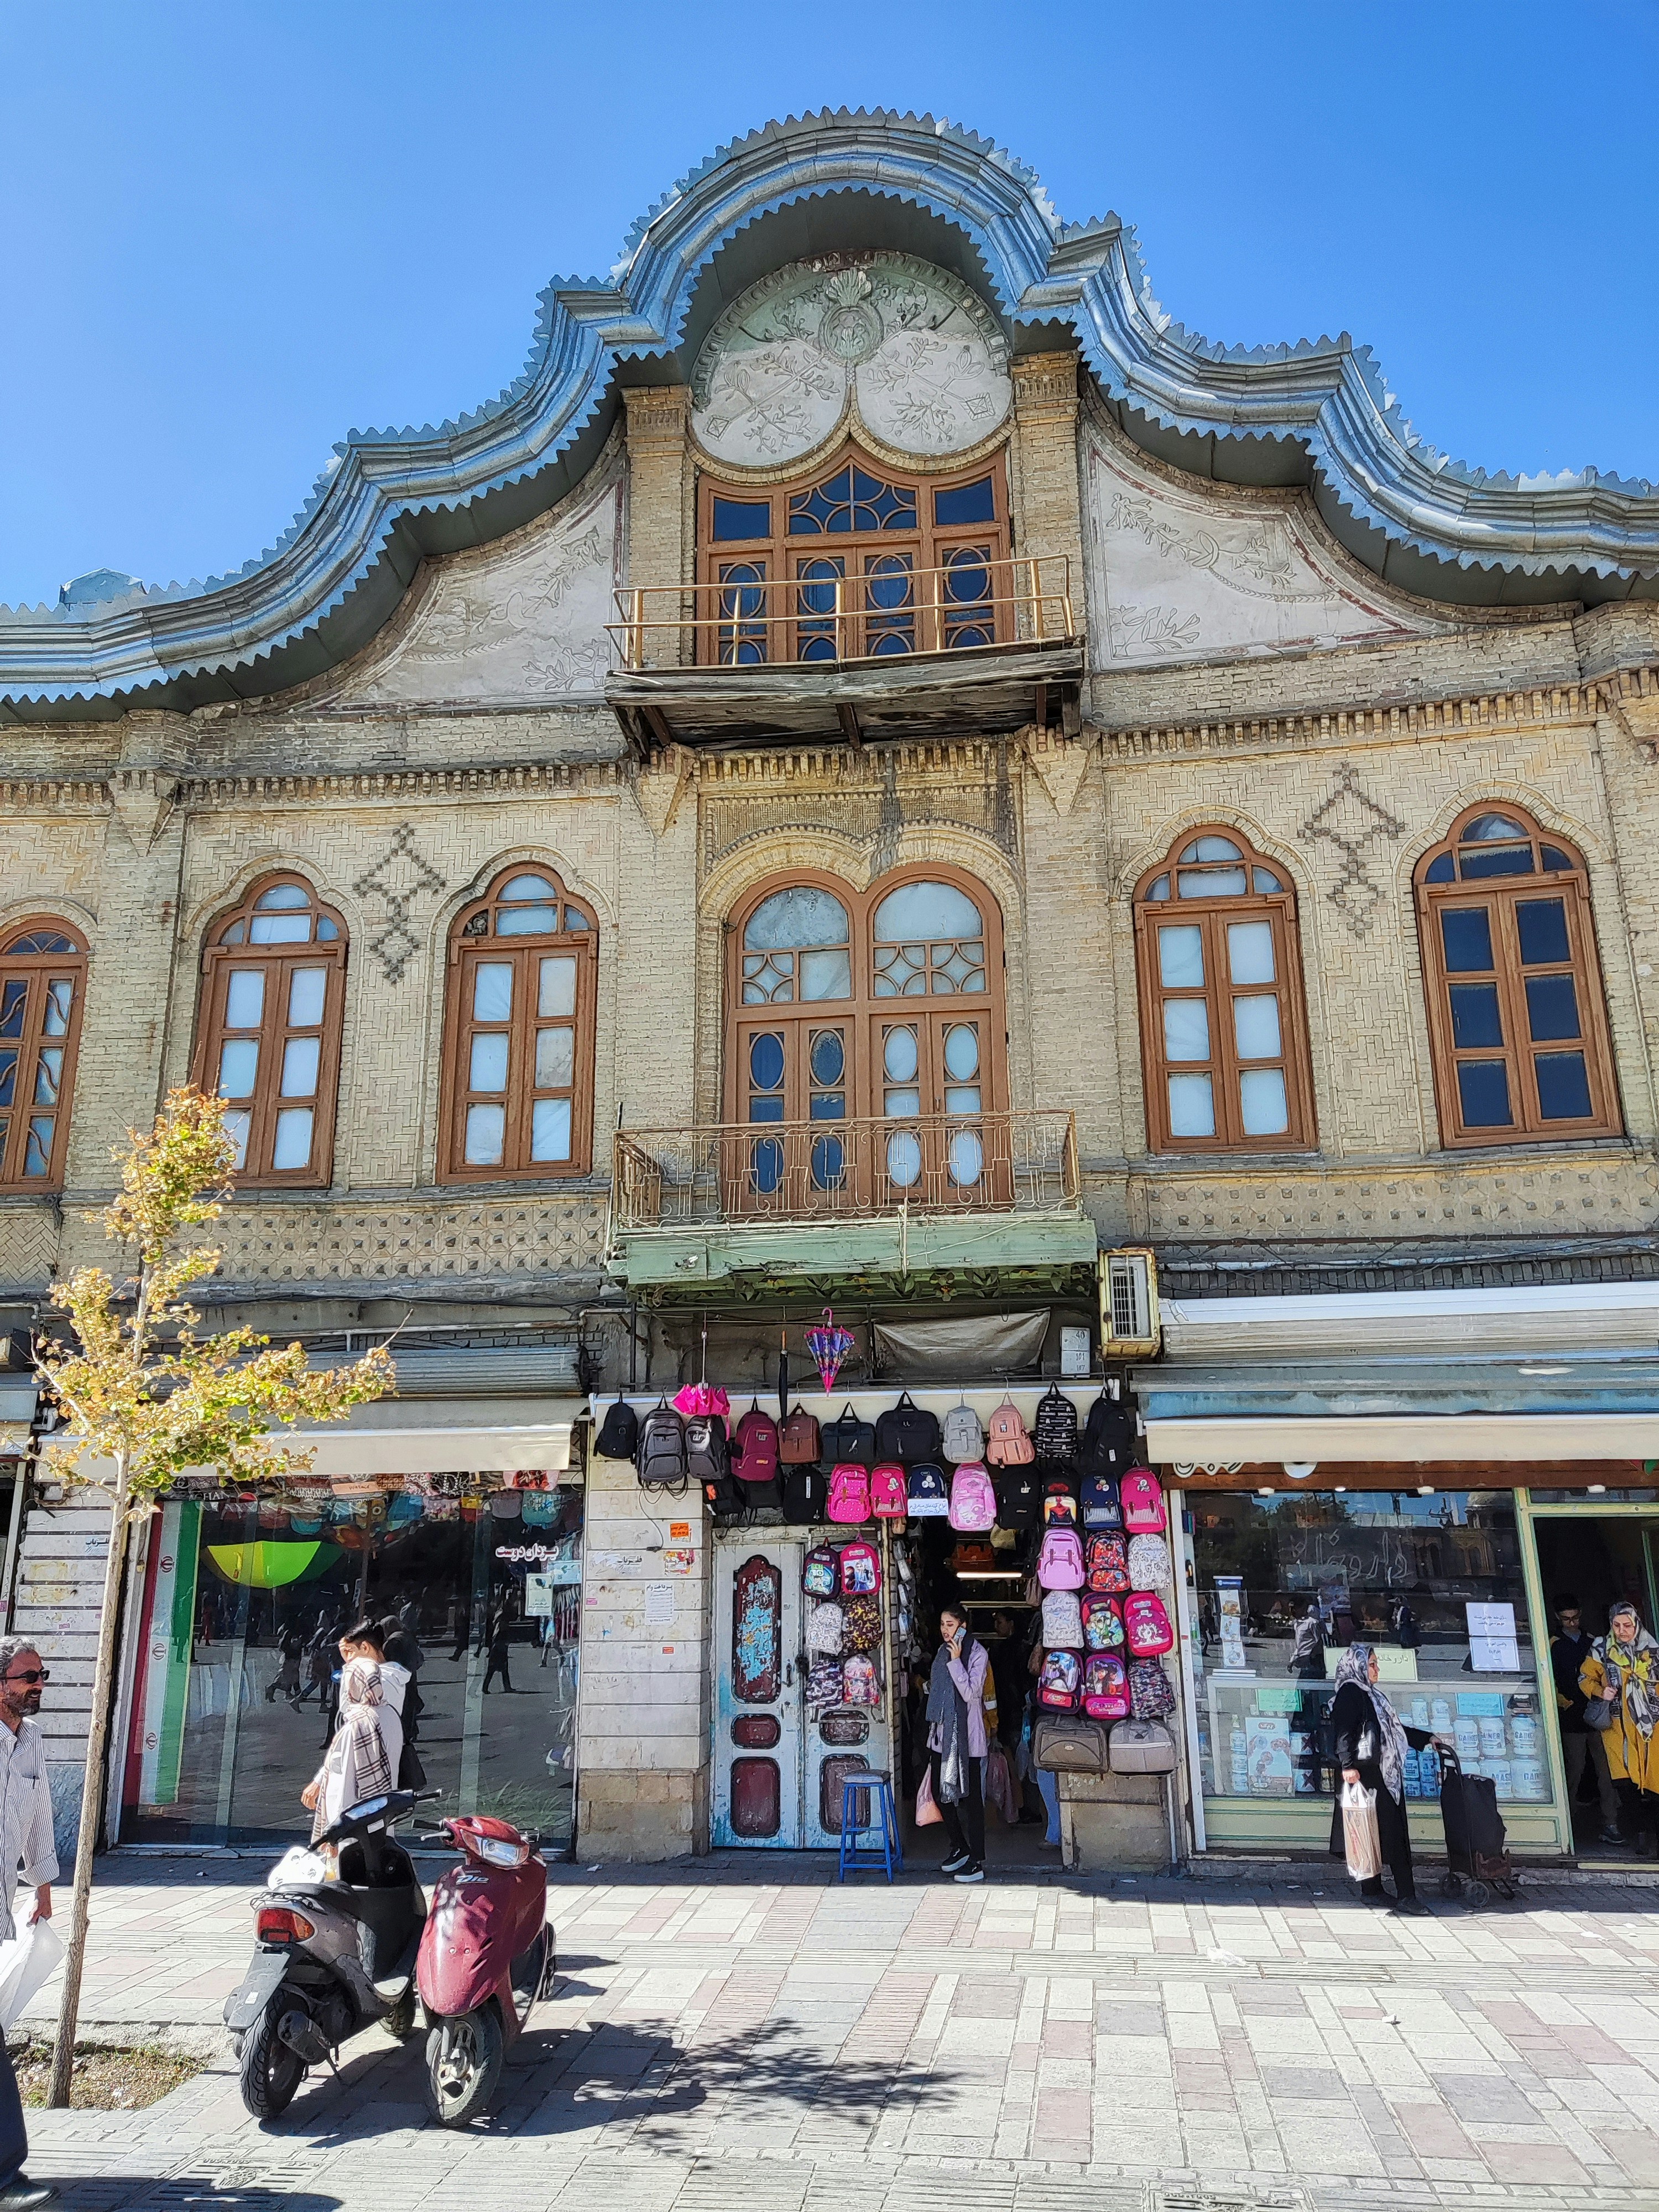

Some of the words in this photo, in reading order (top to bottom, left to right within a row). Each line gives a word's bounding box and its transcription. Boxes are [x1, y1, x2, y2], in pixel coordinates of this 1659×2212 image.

[1076, 1331, 1086, 1339] 40
[1076, 1352, 1085, 1361] 101
[495, 1546, 525, 1562] دوست
[525, 1542, 559, 1562] یزدان
